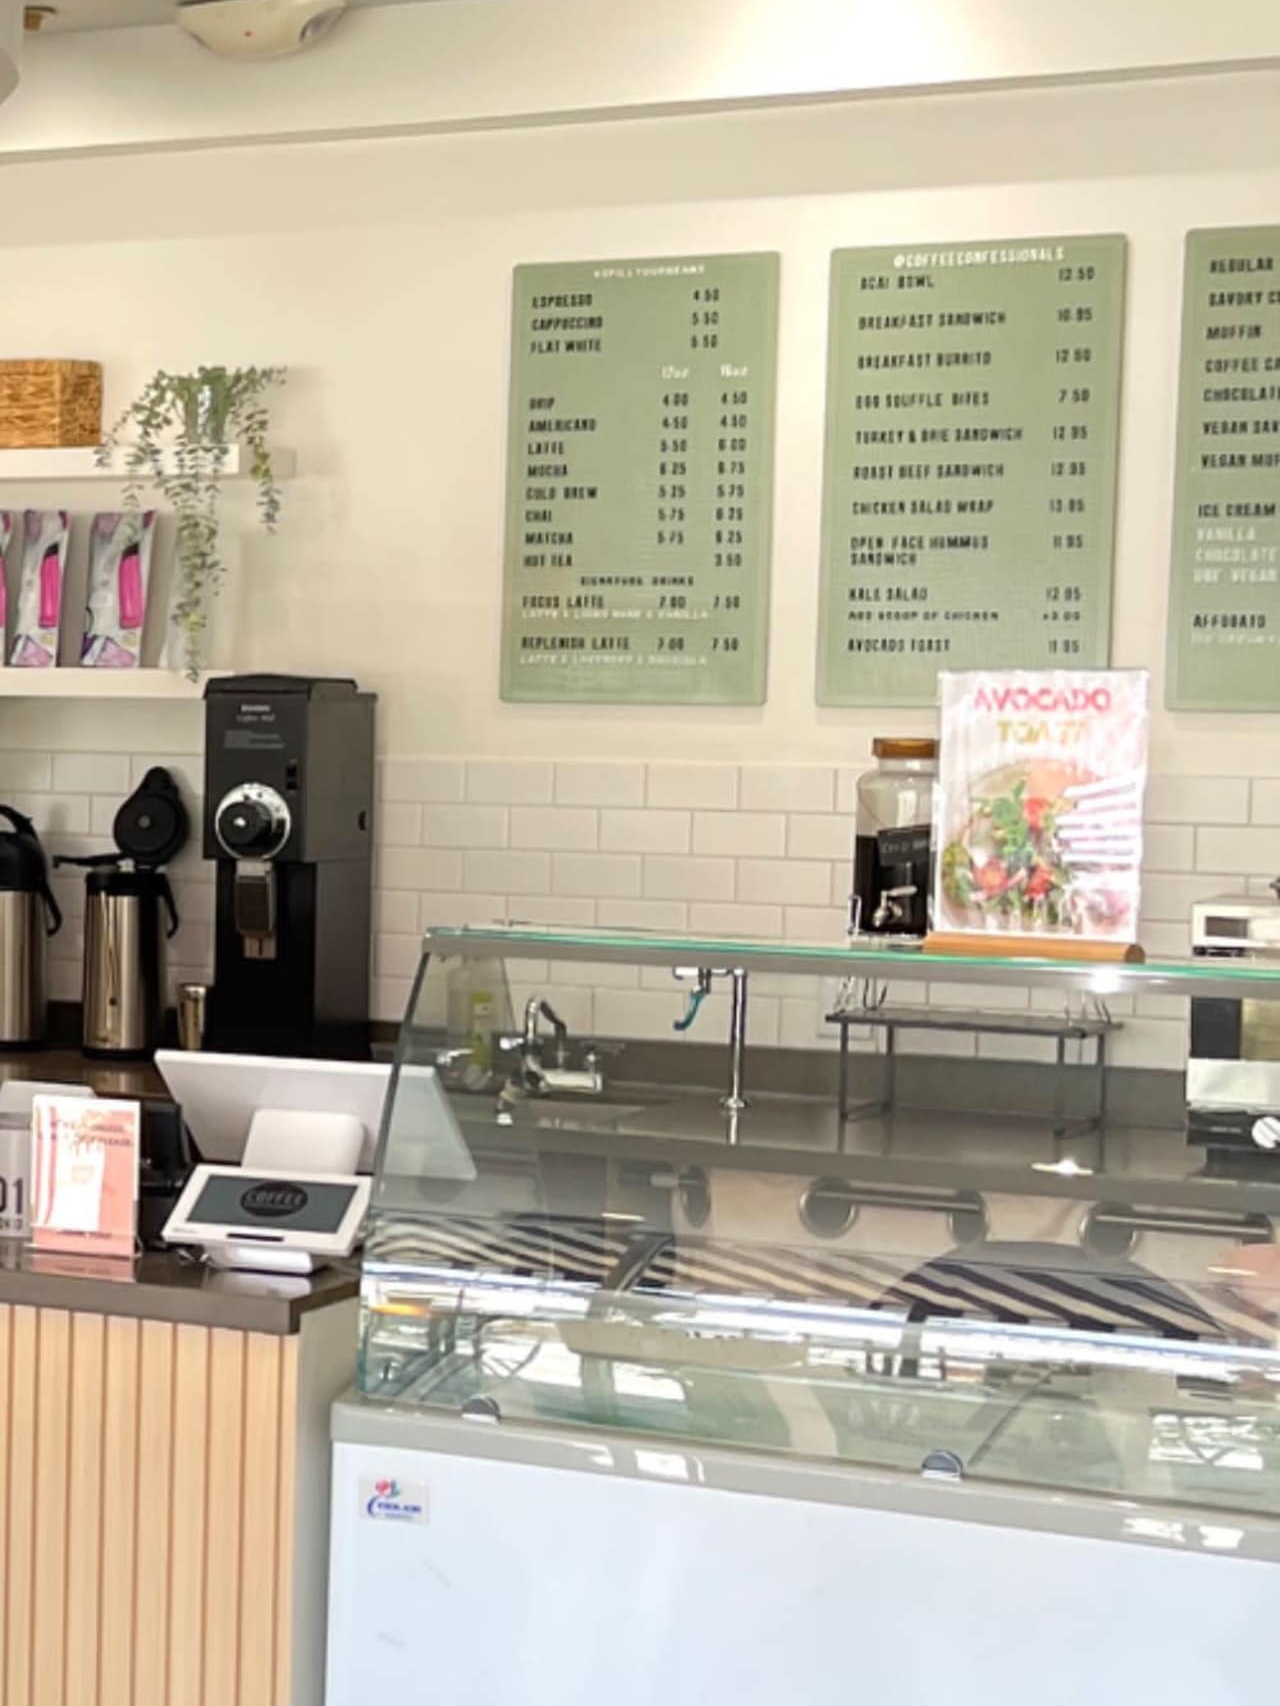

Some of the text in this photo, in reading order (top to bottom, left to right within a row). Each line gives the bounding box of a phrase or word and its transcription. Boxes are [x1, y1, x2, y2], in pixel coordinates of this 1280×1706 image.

[897, 275, 934, 290] BOWL
[532, 294, 592, 308] ESPRESSO
[531, 317, 602, 331] CAPPUCCINO
[859, 314, 933, 330] BREAKFAST
[939, 311, 1006, 327] SANDWICH
[1206, 325, 1261, 340] MUFFIN
[531, 341, 560, 353] FLAT
[565, 339, 601, 352] WHITE
[858, 353, 931, 369] BREAKFAST
[937, 352, 991, 366] BURRITO
[1205, 358, 1259, 373] COFFEE
[886, 393, 943, 408] SOUFFLE
[952, 392, 989, 406] BITES
[529, 419, 596, 432] AMERICANO
[1203, 421, 1248, 435] VEGAN
[856, 430, 904, 443] TURKEY
[921, 429, 949, 443] BRIE
[955, 427, 1023, 442] SANDWICH
[528, 442, 564, 455] LATTE
[1201, 454, 1246, 469] VEGAN
[527, 464, 567, 477] MOCHA
[853, 466, 893, 479] ROAST
[899, 465, 931, 479] BEEF
[937, 464, 1004, 478] SANDWICH
[526, 487, 556, 500] COLD
[564, 487, 597, 499] BREW
[853, 501, 905, 515] CHICKEN
[911, 500, 952, 515] SALAD
[957, 499, 994, 513] WRAP
[1198, 503, 1276, 517] ICE CREAM
[525, 510, 551, 522] CHAI
[525, 532, 573, 544] MATCHA
[851, 537, 884, 550] OPEN
[891, 536, 924, 550] FACE
[929, 535, 989, 549] HUMMUS
[524, 555, 545, 567] HOT
[551, 555, 572, 566] TEA
[850, 553, 916, 566] SANDWICH
[848, 588, 880, 601] KALE
[886, 587, 928, 601] SALAD
[522, 596, 560, 608] FOCUS
[567, 596, 604, 609] LATTE
[1194, 614, 1266, 628] AFFOGATO
[592, 637, 629, 650] LATTE
[848, 639, 905, 653] AVOCADO
[911, 639, 950, 653] TOAST
[974, 687, 1111, 712] AVOCADO
